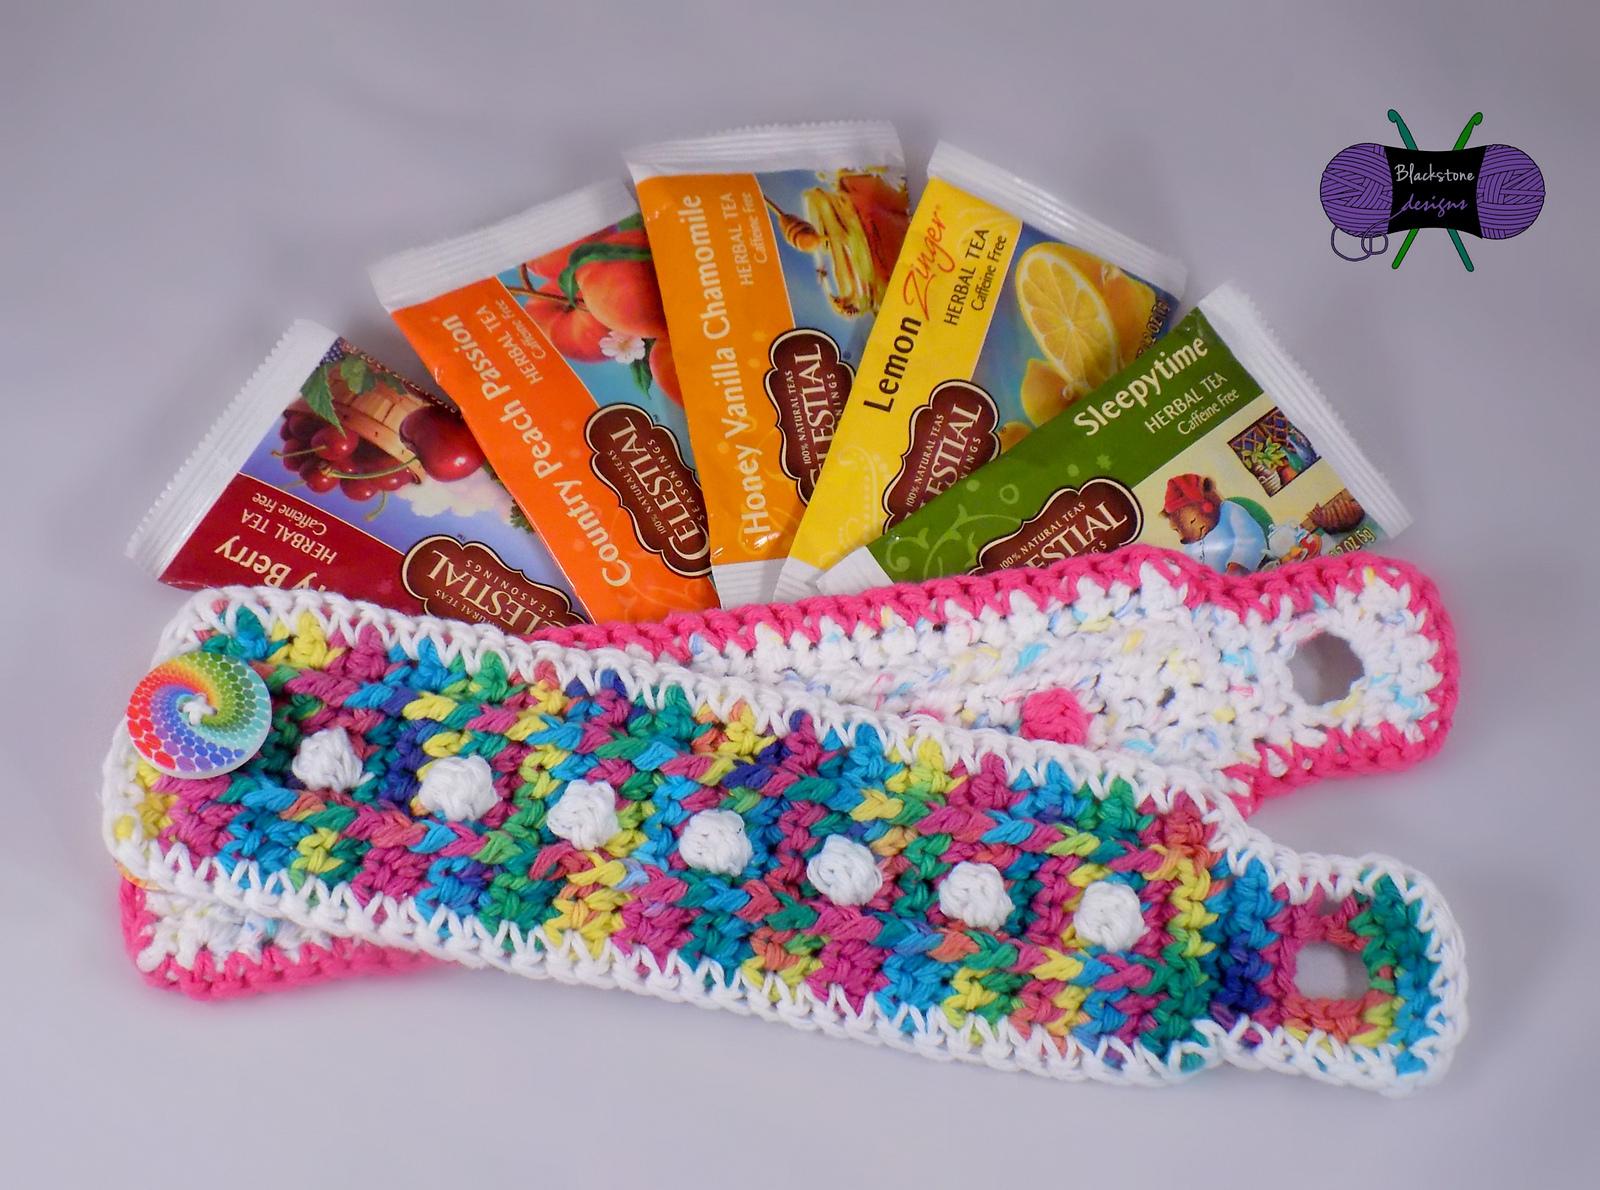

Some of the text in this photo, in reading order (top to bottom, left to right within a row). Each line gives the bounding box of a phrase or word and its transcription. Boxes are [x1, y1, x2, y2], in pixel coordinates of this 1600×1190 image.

[720, 192, 754, 286] HERBAL TEA
[944, 229, 989, 326] HERBAL TEA
[971, 235, 1007, 311] Caffeine Free
[476, 305, 544, 384] HERBAL TEA
[863, 210, 955, 413] Lemon Zinger
[678, 194, 771, 534] Honey Vanilla Chamomile
[1073, 337, 1208, 436] Sleepytime
[1144, 372, 1228, 434] HERBAL TEA
[442, 314, 631, 587] Country Peach Passion
[785, 371, 812, 465] 100% NATURAL TEAS
[1177, 389, 1240, 435] Caffeine Free
[608, 450, 667, 535] 100% NATURAL TEAS
[609, 416, 710, 560] CELESTIAL
[647, 439, 705, 521] SEASONINGS
[906, 414, 945, 507] 100% NATURAL TEAS
[241, 508, 338, 565] HERBAL TEA
[251, 492, 327, 535] Caffeine Free
[1020, 521, 1063, 555] NATURAL
[1063, 501, 1086, 523] TEAS
[214, 535, 292, 588] Berry
[427, 550, 558, 635] LESTIAL
[435, 589, 459, 608] TEAS
[465, 559, 555, 618] SEASONINGS
